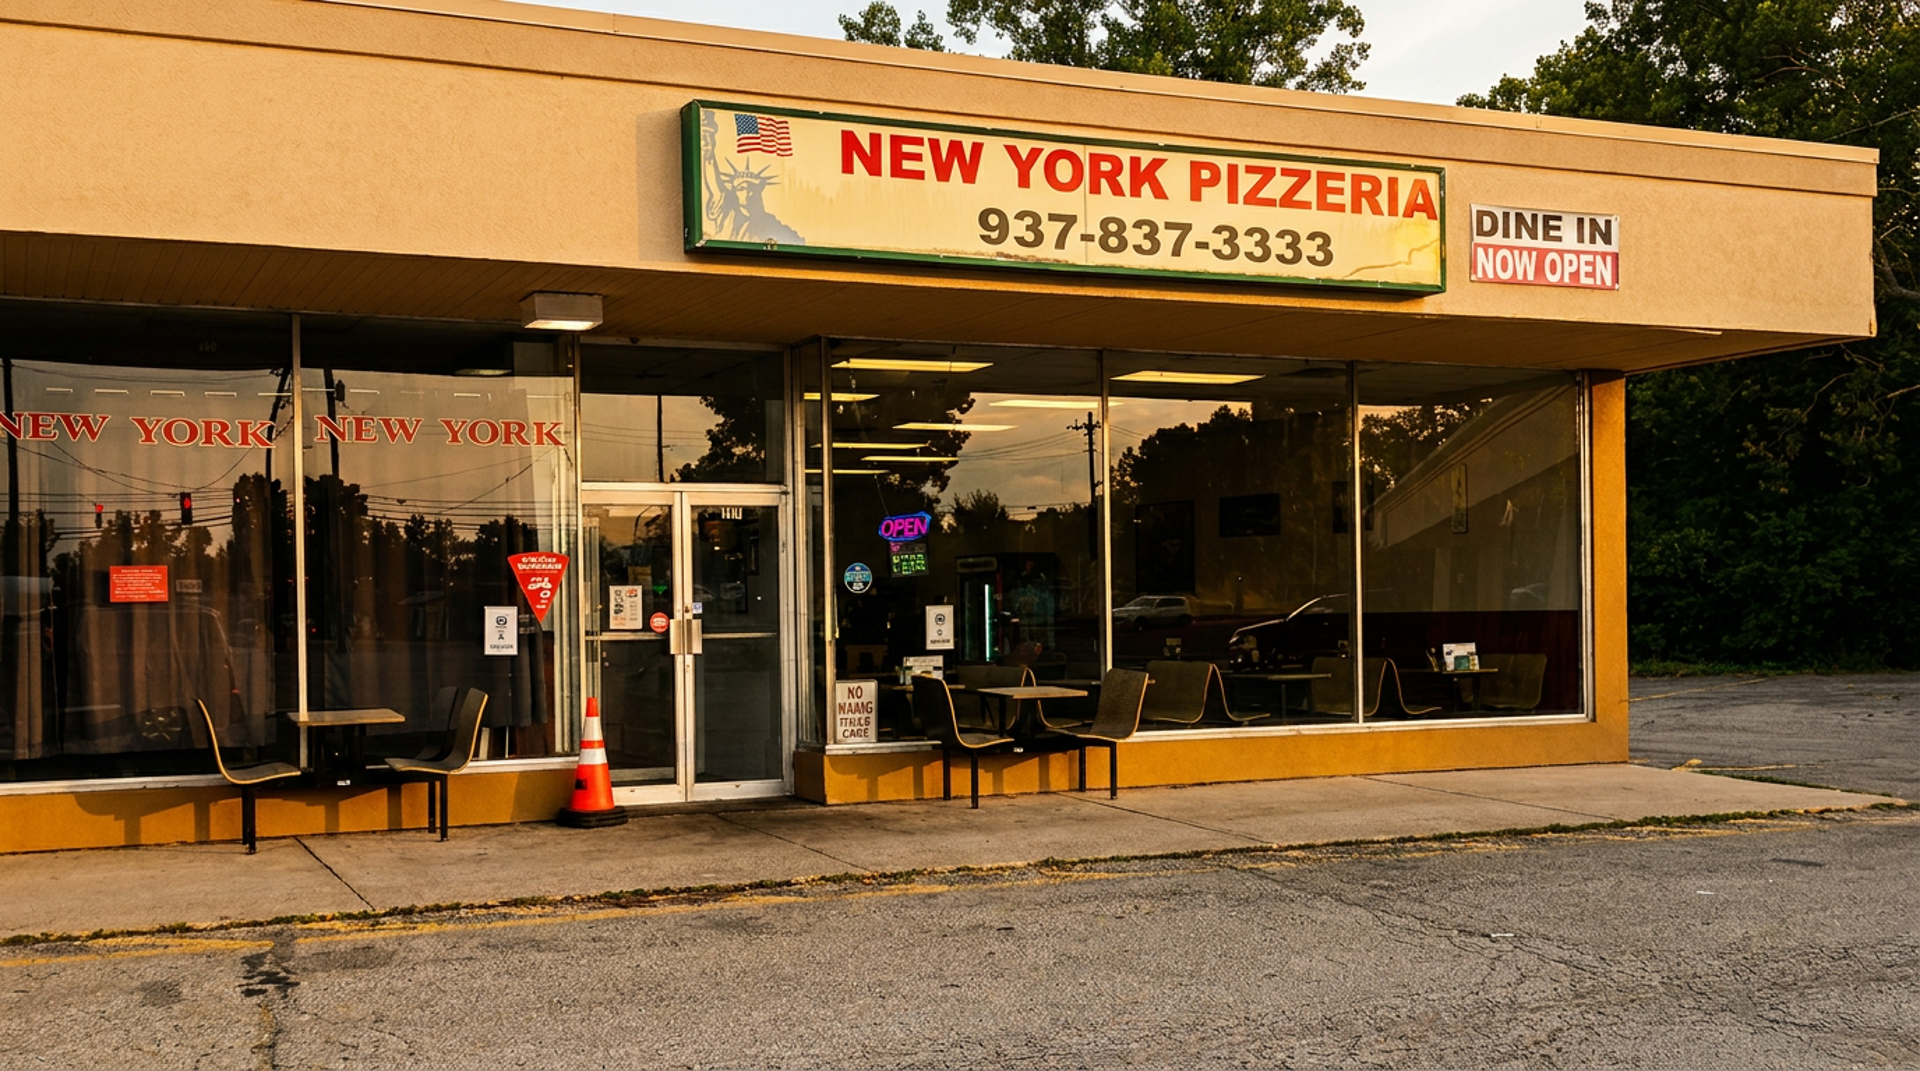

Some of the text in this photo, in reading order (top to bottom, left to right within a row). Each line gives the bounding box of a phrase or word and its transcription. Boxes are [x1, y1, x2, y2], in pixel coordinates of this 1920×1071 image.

[841, 129, 1438, 220] NEW YORK PIZZERIA
[978, 207, 1334, 267] 937-837-3333
[1476, 209, 1612, 246] DINE IN
[1477, 247, 1612, 286] NOW OPEN
[130, 417, 276, 448] YORK
[314, 415, 566, 447] NEW YORK
[881, 517, 928, 537] OPEN
[847, 685, 863, 699] NO
